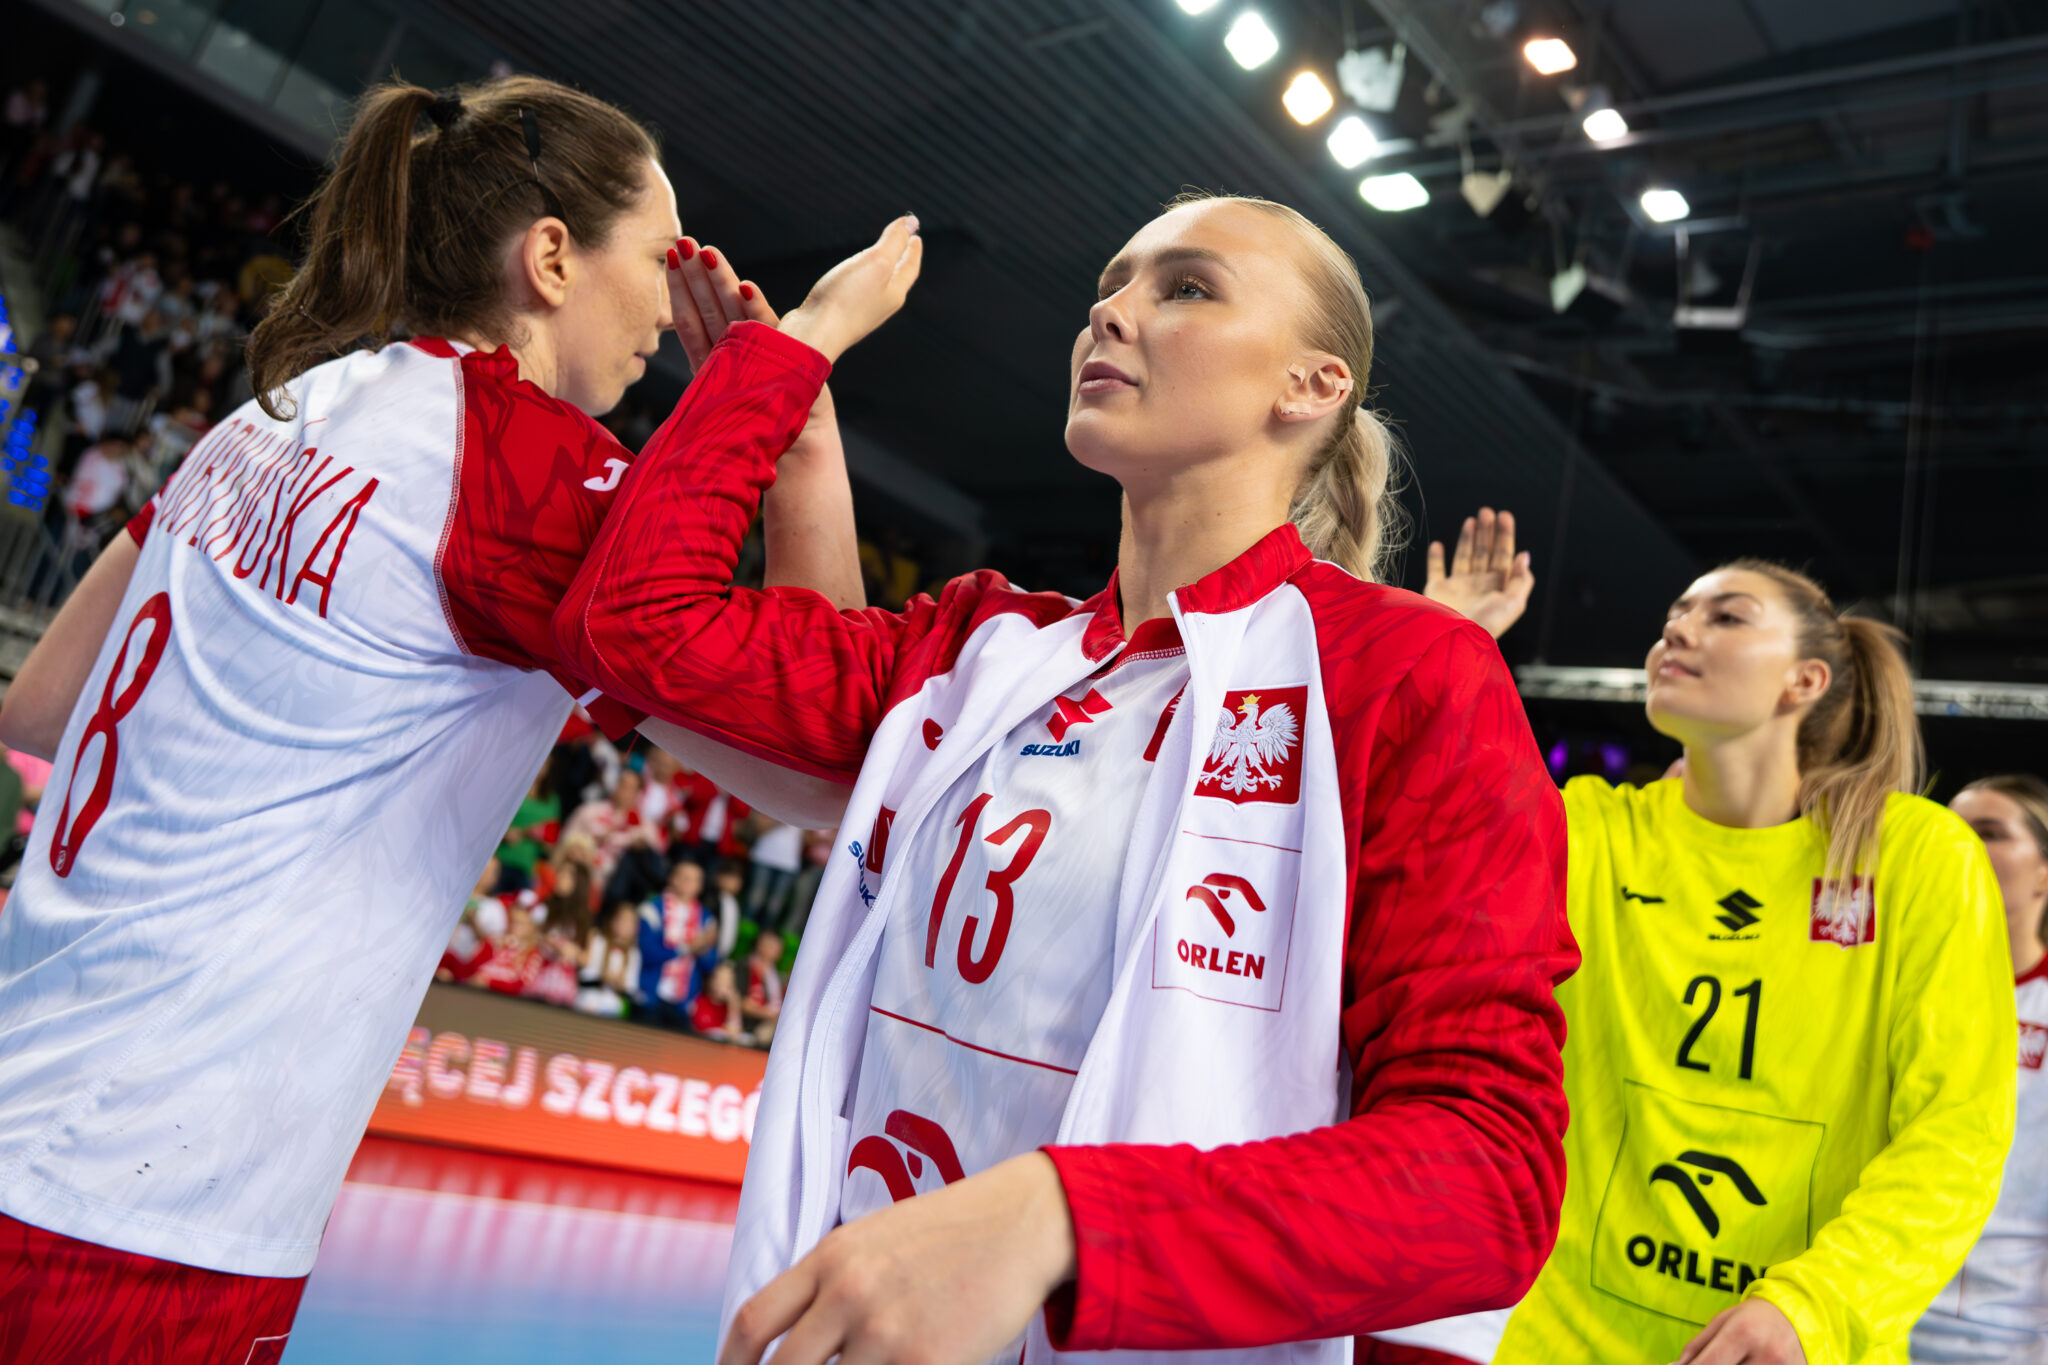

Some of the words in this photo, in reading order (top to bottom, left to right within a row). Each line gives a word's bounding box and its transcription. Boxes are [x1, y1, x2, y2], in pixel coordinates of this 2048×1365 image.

[49, 591, 172, 878] 8
[1020, 740, 1080, 757] SUZUKI
[925, 792, 1052, 984] 13
[1177, 938, 1265, 980] ORLEN
[1675, 973, 1763, 1081] 21
